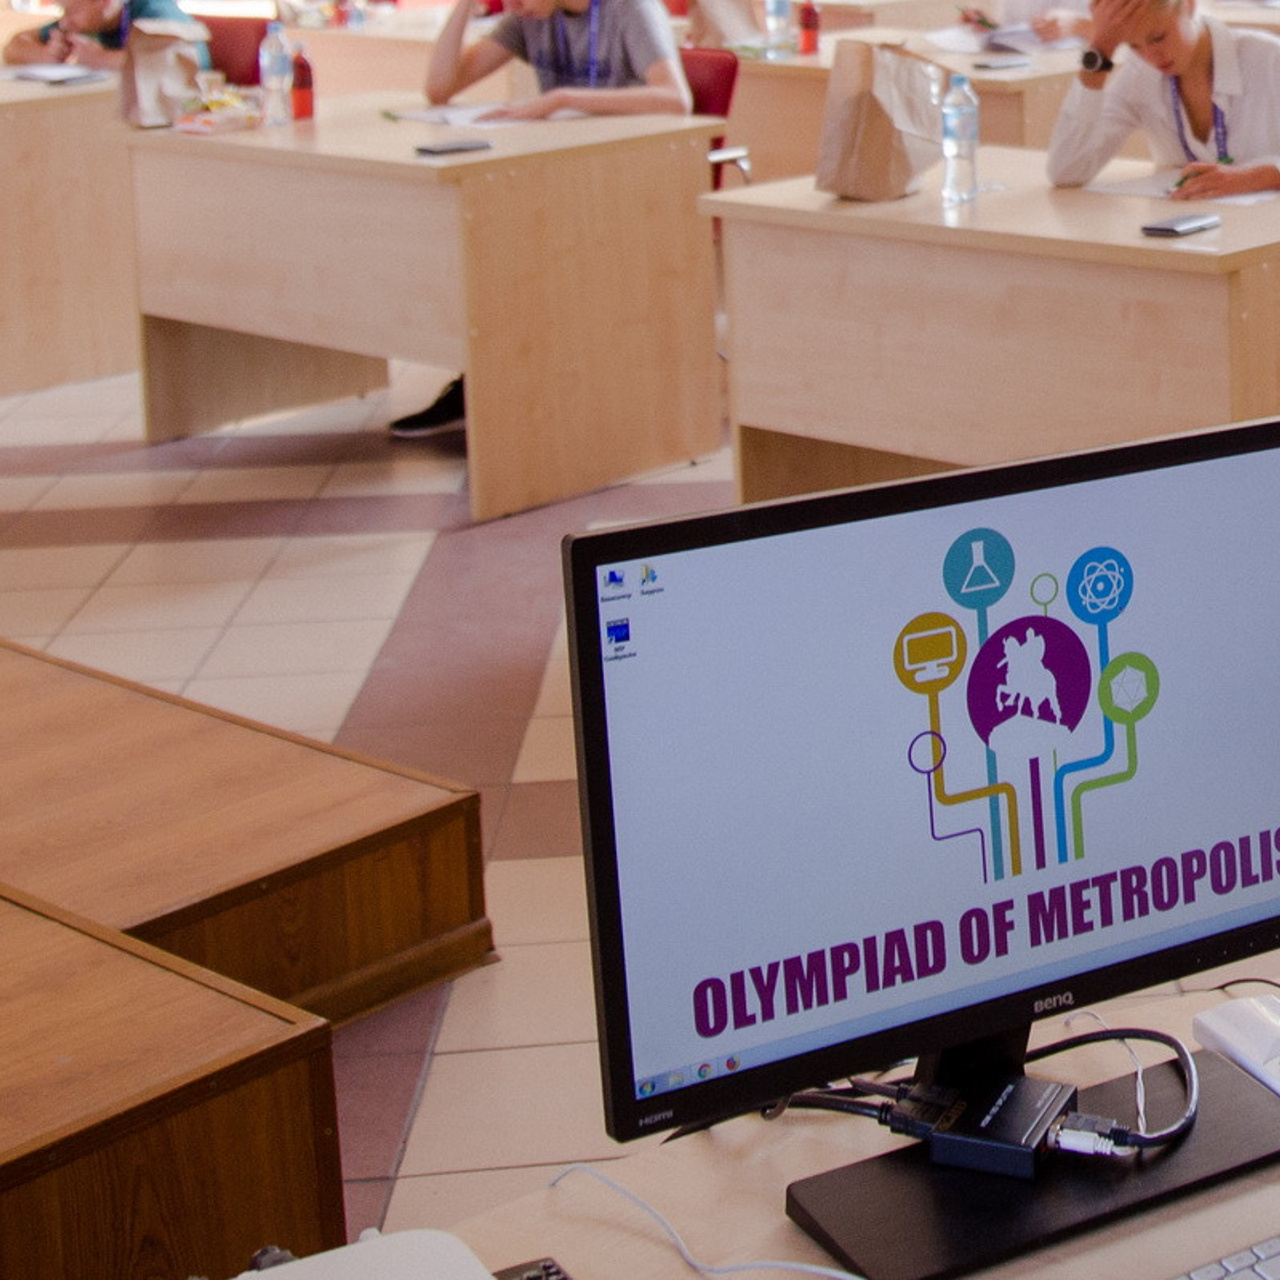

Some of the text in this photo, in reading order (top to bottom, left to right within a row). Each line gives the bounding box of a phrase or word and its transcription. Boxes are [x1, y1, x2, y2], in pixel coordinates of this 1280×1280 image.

[693, 919, 947, 1038] OLYMPIAD
[959, 900, 1016, 966] OF
[1033, 990, 1075, 1014] BenQ
